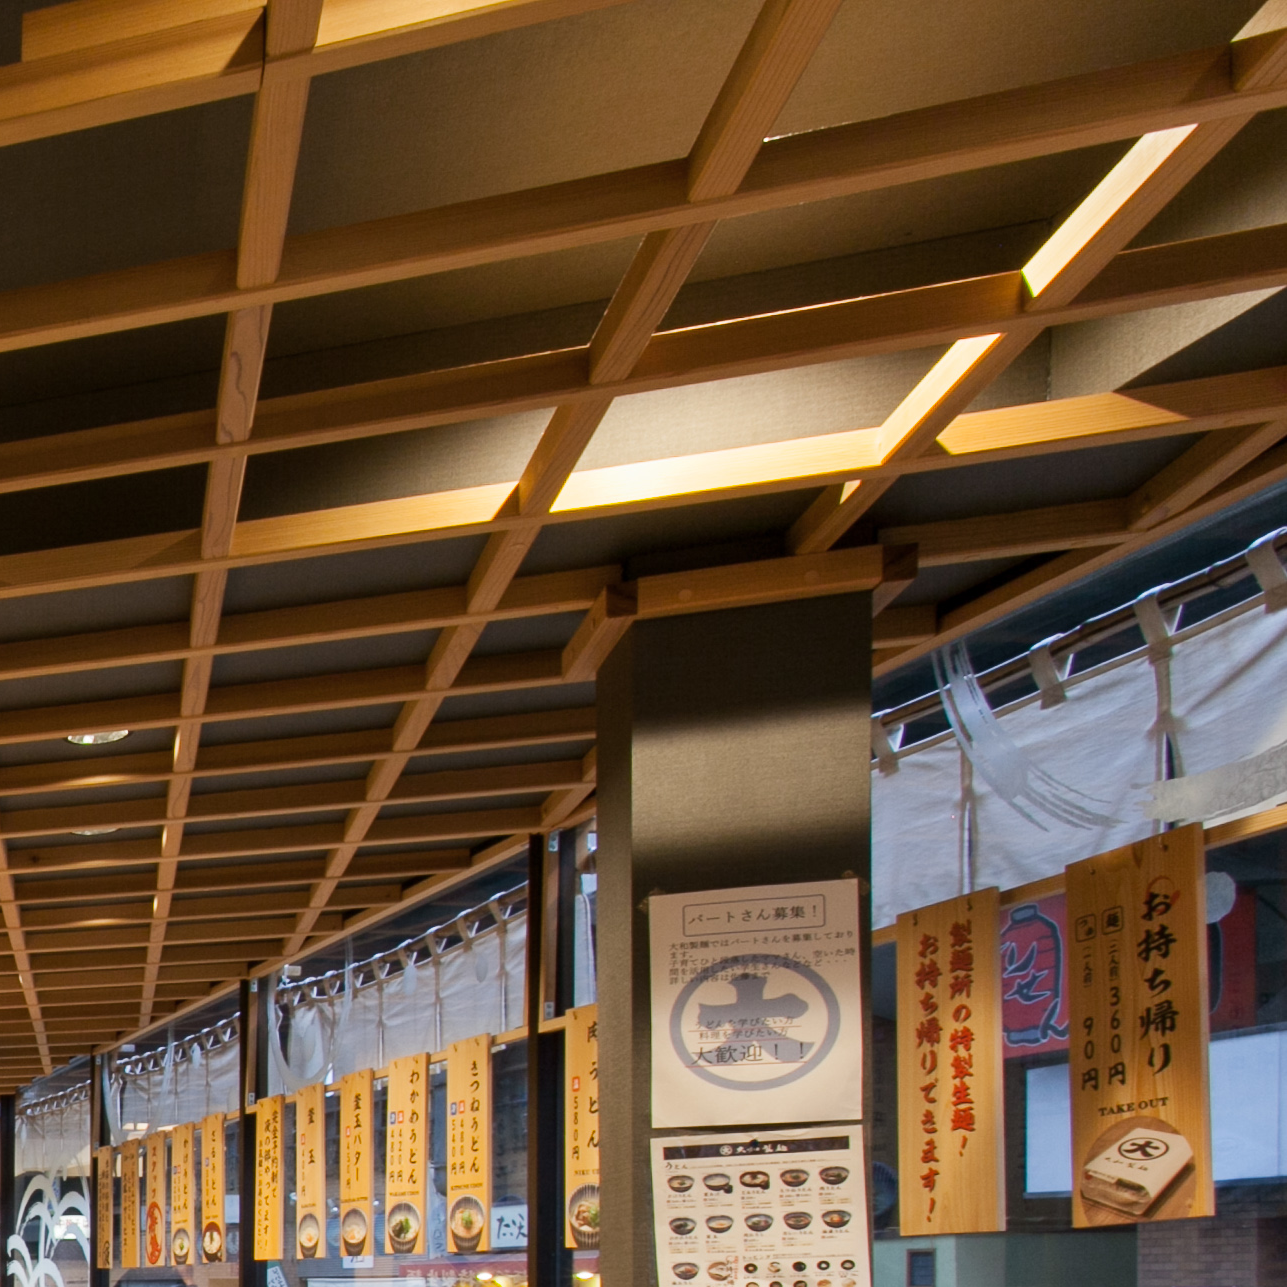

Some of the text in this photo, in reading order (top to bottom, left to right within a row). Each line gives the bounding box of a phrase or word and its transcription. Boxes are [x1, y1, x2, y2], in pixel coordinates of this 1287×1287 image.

[688, 905, 818, 924] パートさん募集！
[949, 919, 976, 1158] 製麺所の特製生麺！
[1108, 986, 1126, 1086] 360円
[1136, 890, 1180, 1077] お持ち帰り
[915, 931, 943, 1223] お持ち帰りできます！
[1081, 1016, 1099, 1092] 90円
[1098, 1097, 1169, 1117] TAKE OUT
[407, 1069, 420, 1185] わかめうどん
[470, 1060, 480, 1173] きつねうどん
